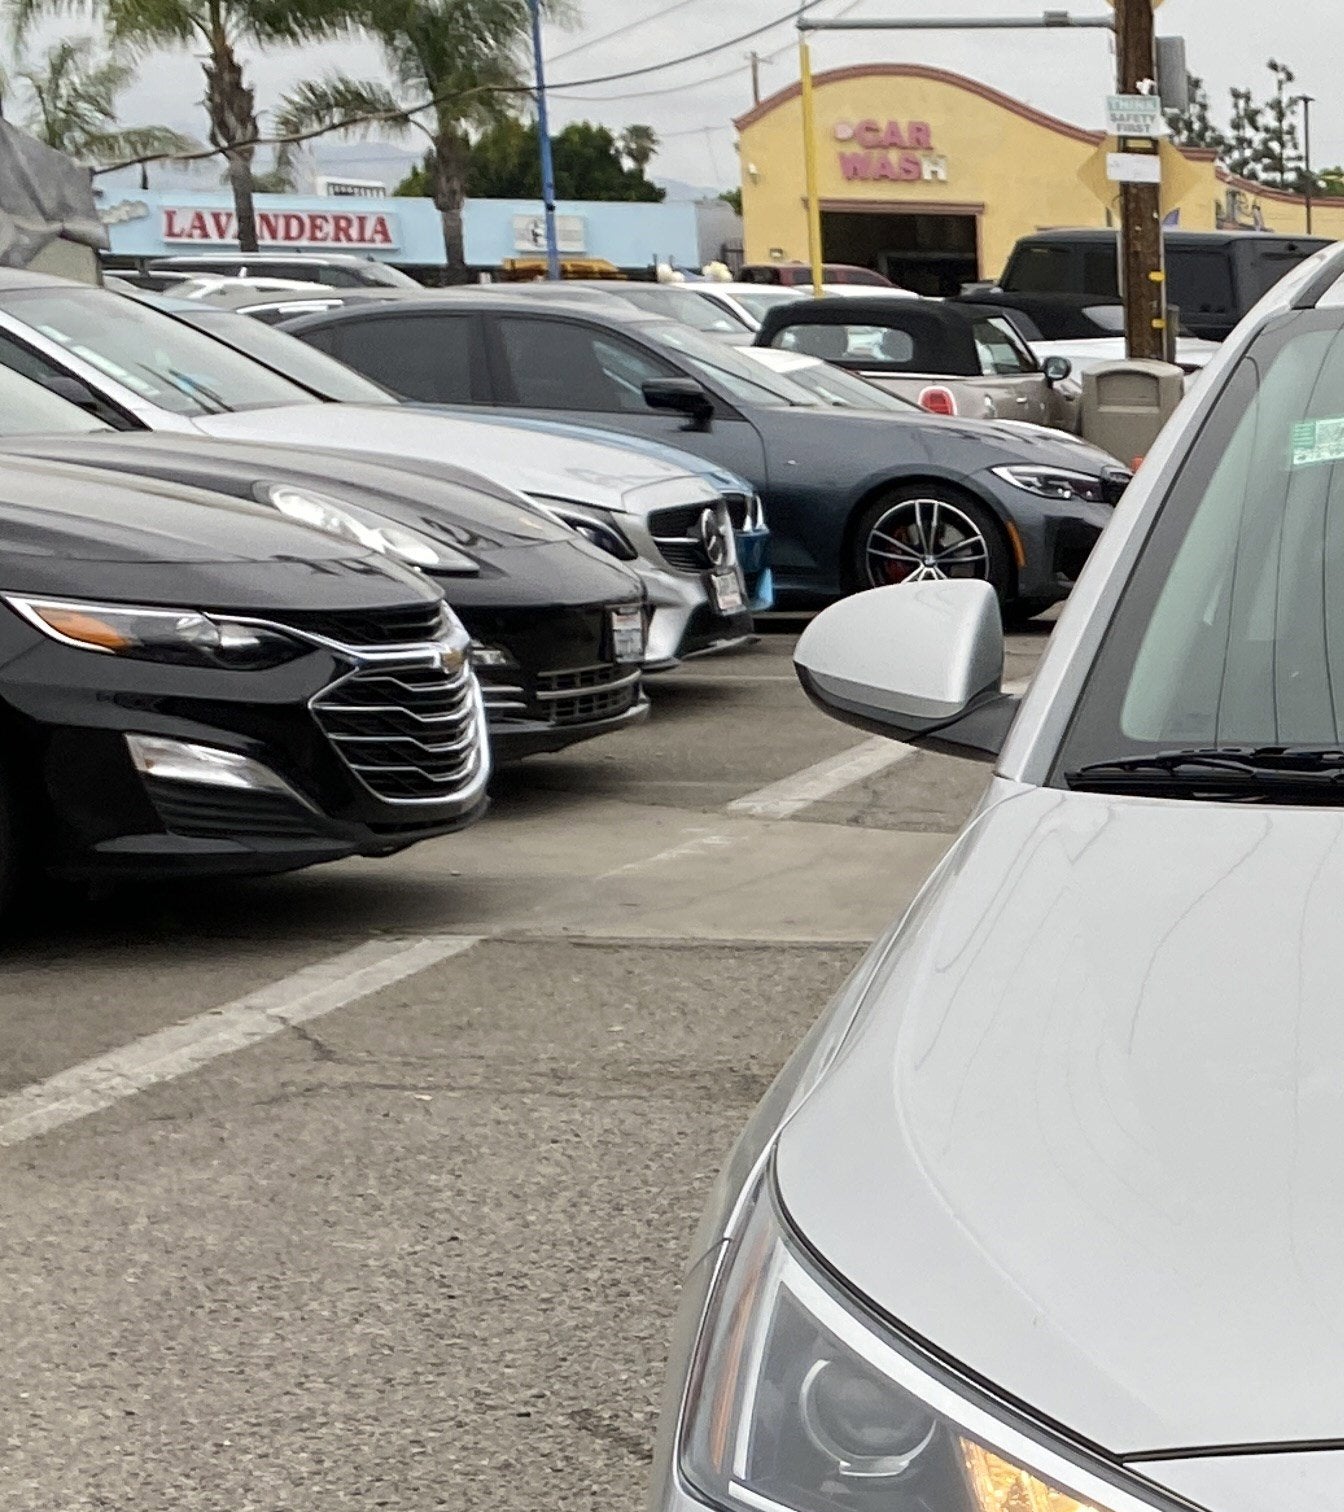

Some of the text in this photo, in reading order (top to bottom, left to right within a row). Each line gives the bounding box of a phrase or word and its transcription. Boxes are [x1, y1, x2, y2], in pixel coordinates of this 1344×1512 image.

[1110, 113, 1156, 123] SAFETY
[1116, 123, 1151, 133] FIRST
[854, 119, 933, 150] CAR
[838, 151, 948, 183] WASH
[164, 210, 392, 244] LAVNDERIA
